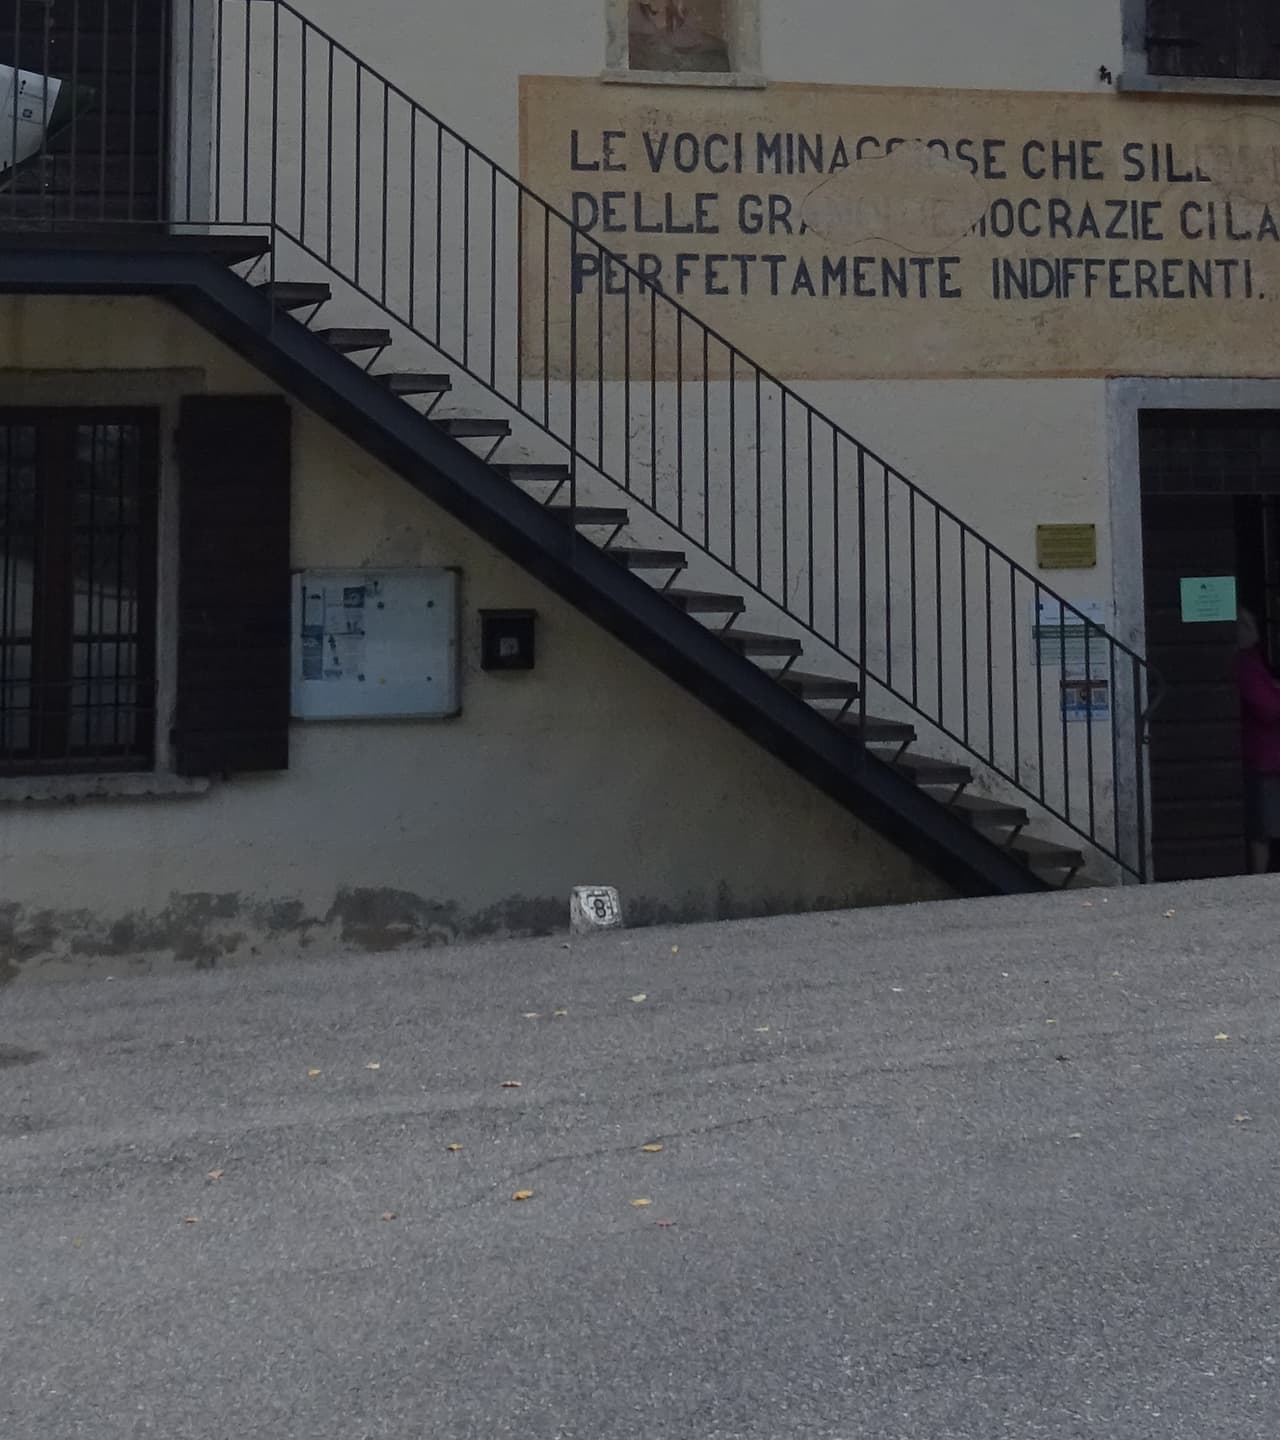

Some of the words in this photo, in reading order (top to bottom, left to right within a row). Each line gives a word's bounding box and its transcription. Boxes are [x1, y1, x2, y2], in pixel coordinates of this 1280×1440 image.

[570, 129, 627, 172] LE
[642, 131, 742, 174] VOCI
[1021, 139, 1105, 181] CHE
[571, 191, 720, 234] DELLE
[593, 898, 607, 918] 8
